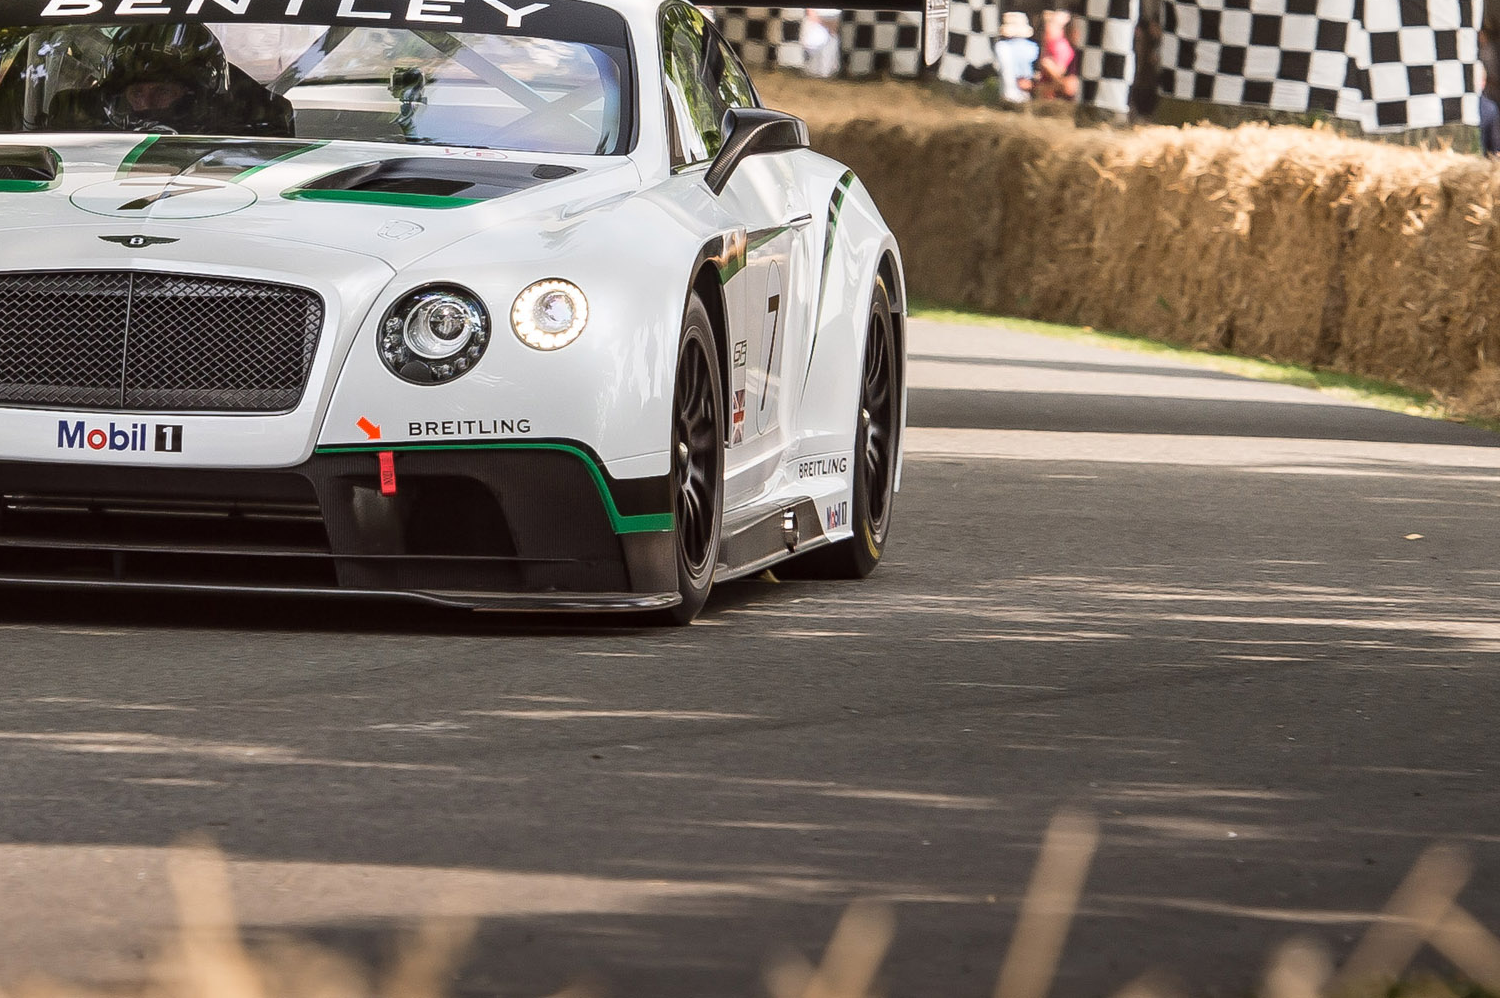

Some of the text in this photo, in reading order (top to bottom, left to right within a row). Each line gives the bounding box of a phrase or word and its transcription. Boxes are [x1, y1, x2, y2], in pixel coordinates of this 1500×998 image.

[760, 293, 781, 412] 7
[57, 420, 177, 451] Mobil 1
[408, 418, 532, 436] BREITLING
[799, 457, 847, 479] BREITLING
